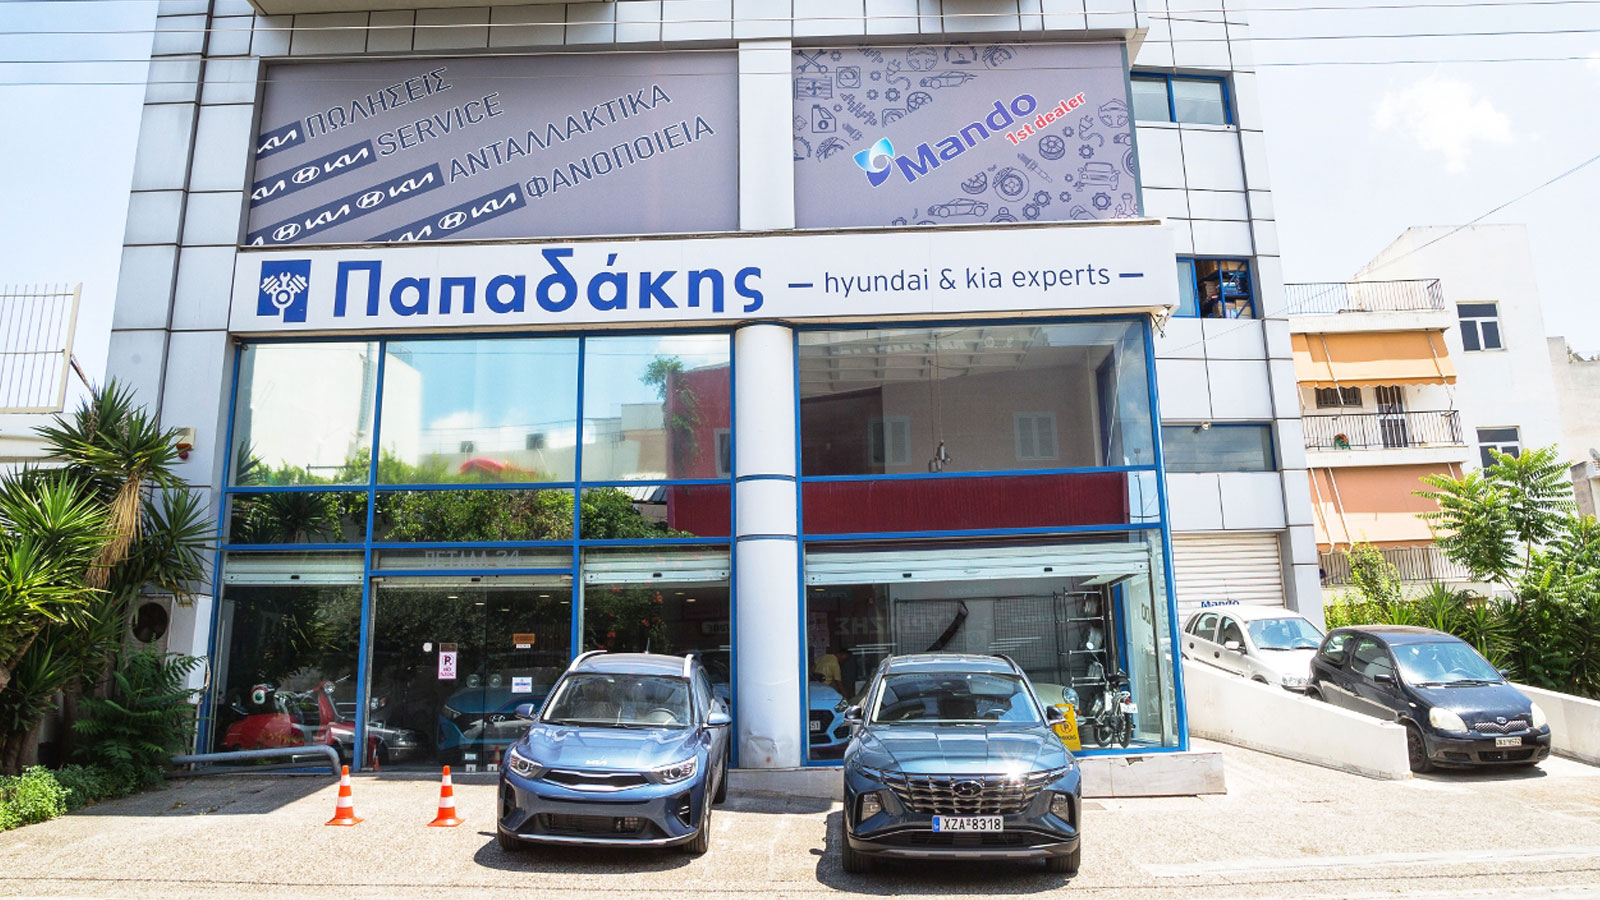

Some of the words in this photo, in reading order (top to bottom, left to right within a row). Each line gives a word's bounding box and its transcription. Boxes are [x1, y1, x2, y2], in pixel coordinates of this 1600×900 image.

[376, 93, 505, 157] SERVICE
[449, 83, 672, 184] ΑΝΤΑΛΛΑΚΤΙΚΑ
[894, 94, 1037, 183] Mando
[1004, 126, 1034, 147] 1st
[1034, 92, 1086, 130] dealer
[526, 115, 716, 200] ΦΑΝΟΠΟΙΕΙΑ
[333, 248, 764, 318] Παπαδάκης
[824, 268, 929, 297] hyundai
[938, 268, 957, 290] &
[965, 267, 1001, 290] kia
[1011, 264, 1111, 291] experts
[495, 550, 519, 568] 24
